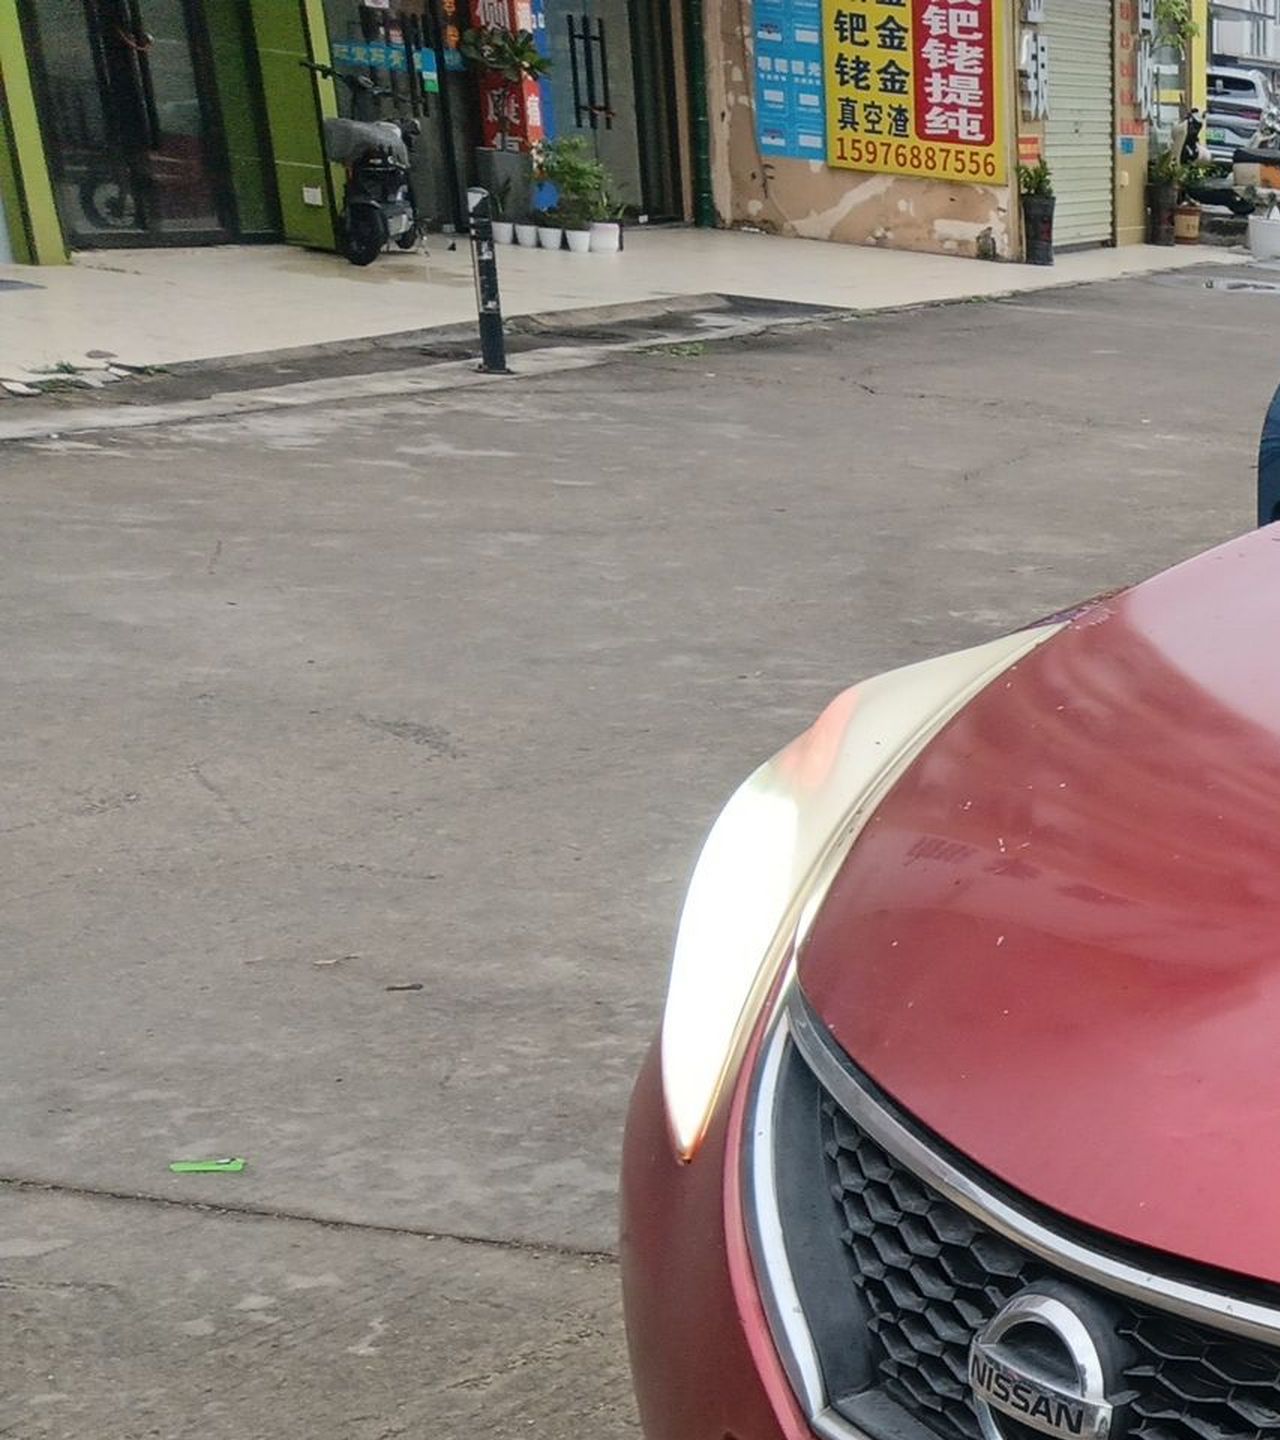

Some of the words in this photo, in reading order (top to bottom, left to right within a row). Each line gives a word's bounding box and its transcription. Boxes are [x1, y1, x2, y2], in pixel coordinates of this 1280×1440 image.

[833, 9, 909, 51] 钯金
[834, 53, 910, 95] 铑金
[921, 0, 986, 141] 钯铑提纯
[837, 97, 910, 138] 真空渣
[836, 137, 996, 177] 15976887556
[970, 1355, 1085, 1436] NISSAN
